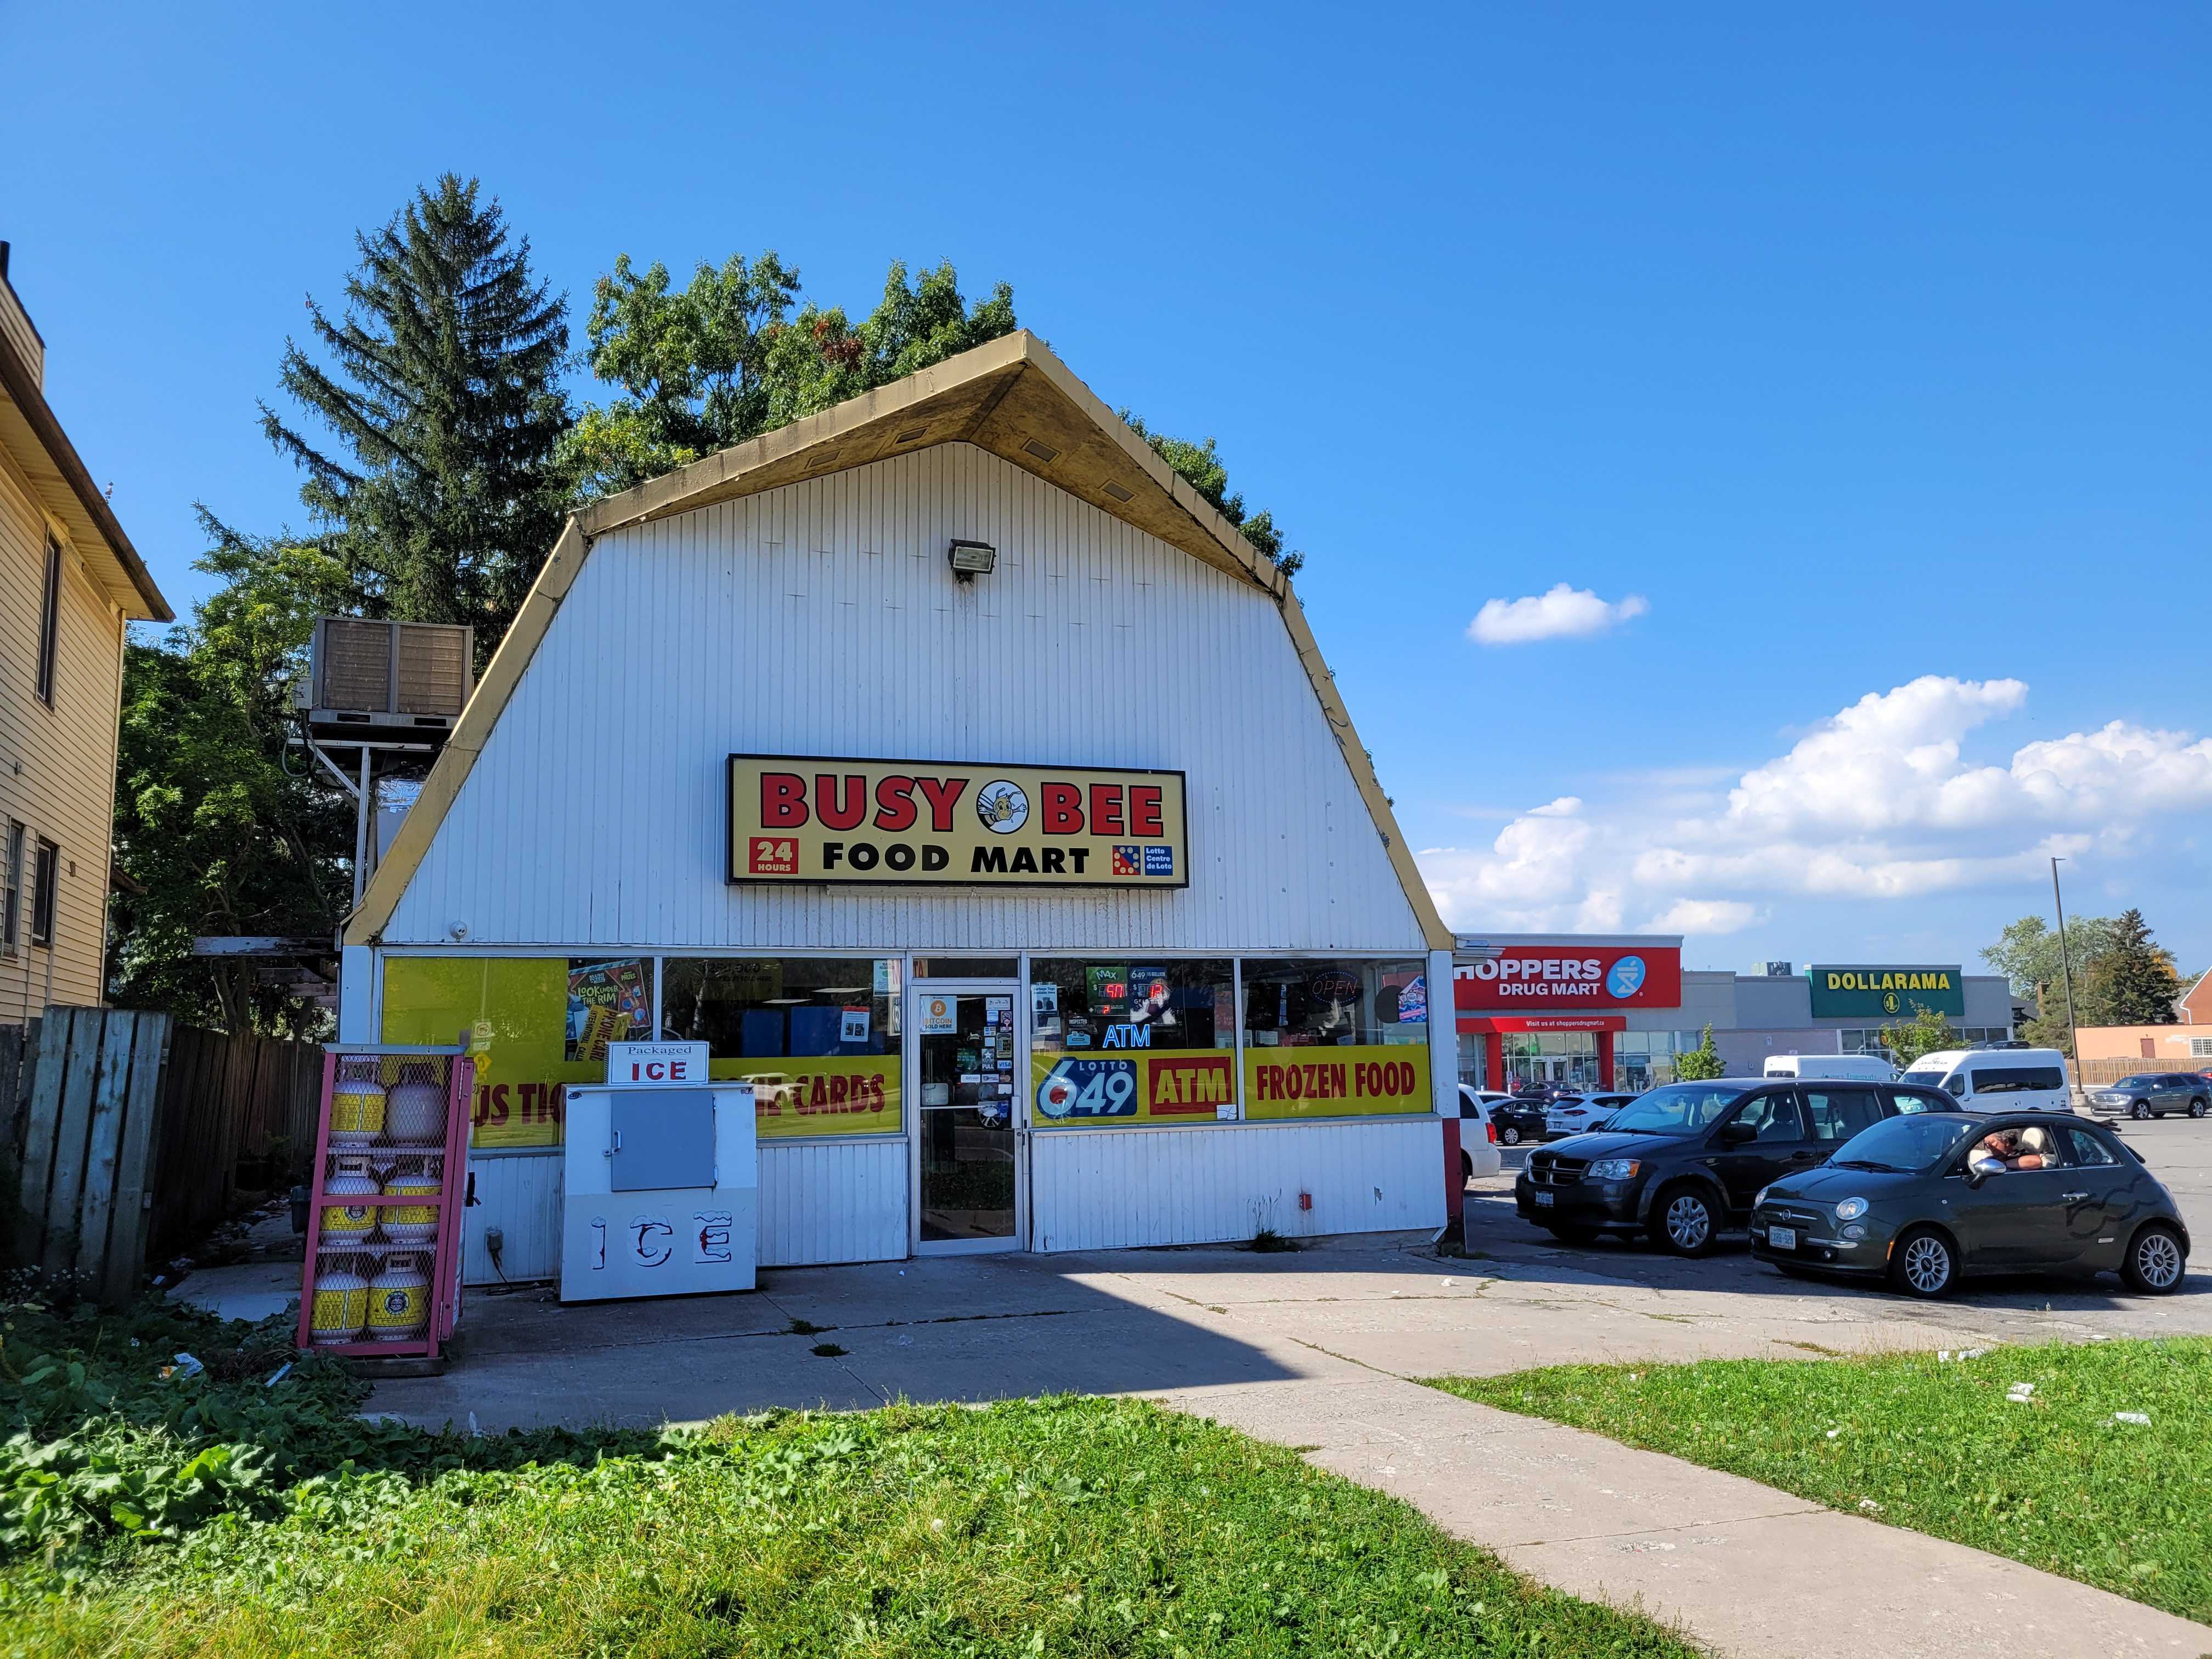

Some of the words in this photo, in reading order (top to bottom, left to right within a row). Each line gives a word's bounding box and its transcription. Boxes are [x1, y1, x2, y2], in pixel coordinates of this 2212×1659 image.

[760, 772, 970, 832] BUSY
[1041, 782, 1164, 837] BEE
[757, 842, 791, 861] 24
[823, 842, 949, 872] FOOD
[971, 847, 1090, 874] MART
[758, 864, 791, 872] HOURS
[1096, 970, 1116, 980] MAX
[1131, 970, 1146, 978] 649
[1827, 973, 1950, 990] DOLLARAMA
[578, 986, 600, 997] LOOK
[1312, 979, 1357, 995] OPEN
[1499, 983, 1548, 996] DRUG
[1552, 983, 1600, 995] MART
[582, 997, 596, 1005] THE
[597, 993, 616, 1005] RIM
[582, 1009, 597, 1043] INTERNATIONAL
[1103, 1024, 1150, 1048] ATM
[628, 1046, 692, 1056] Packaged
[632, 1060, 686, 1081] ICE
[1080, 1061, 1127, 1071] LOTTO
[1040, 1060, 1133, 1115] 649
[1155, 1068, 1227, 1104] ATM
[1257, 1063, 1346, 1101] FROZEN
[1355, 1062, 1415, 1098] FOOD
[793, 1074, 885, 1115] CARDS
[591, 1210, 732, 1271] ICE
